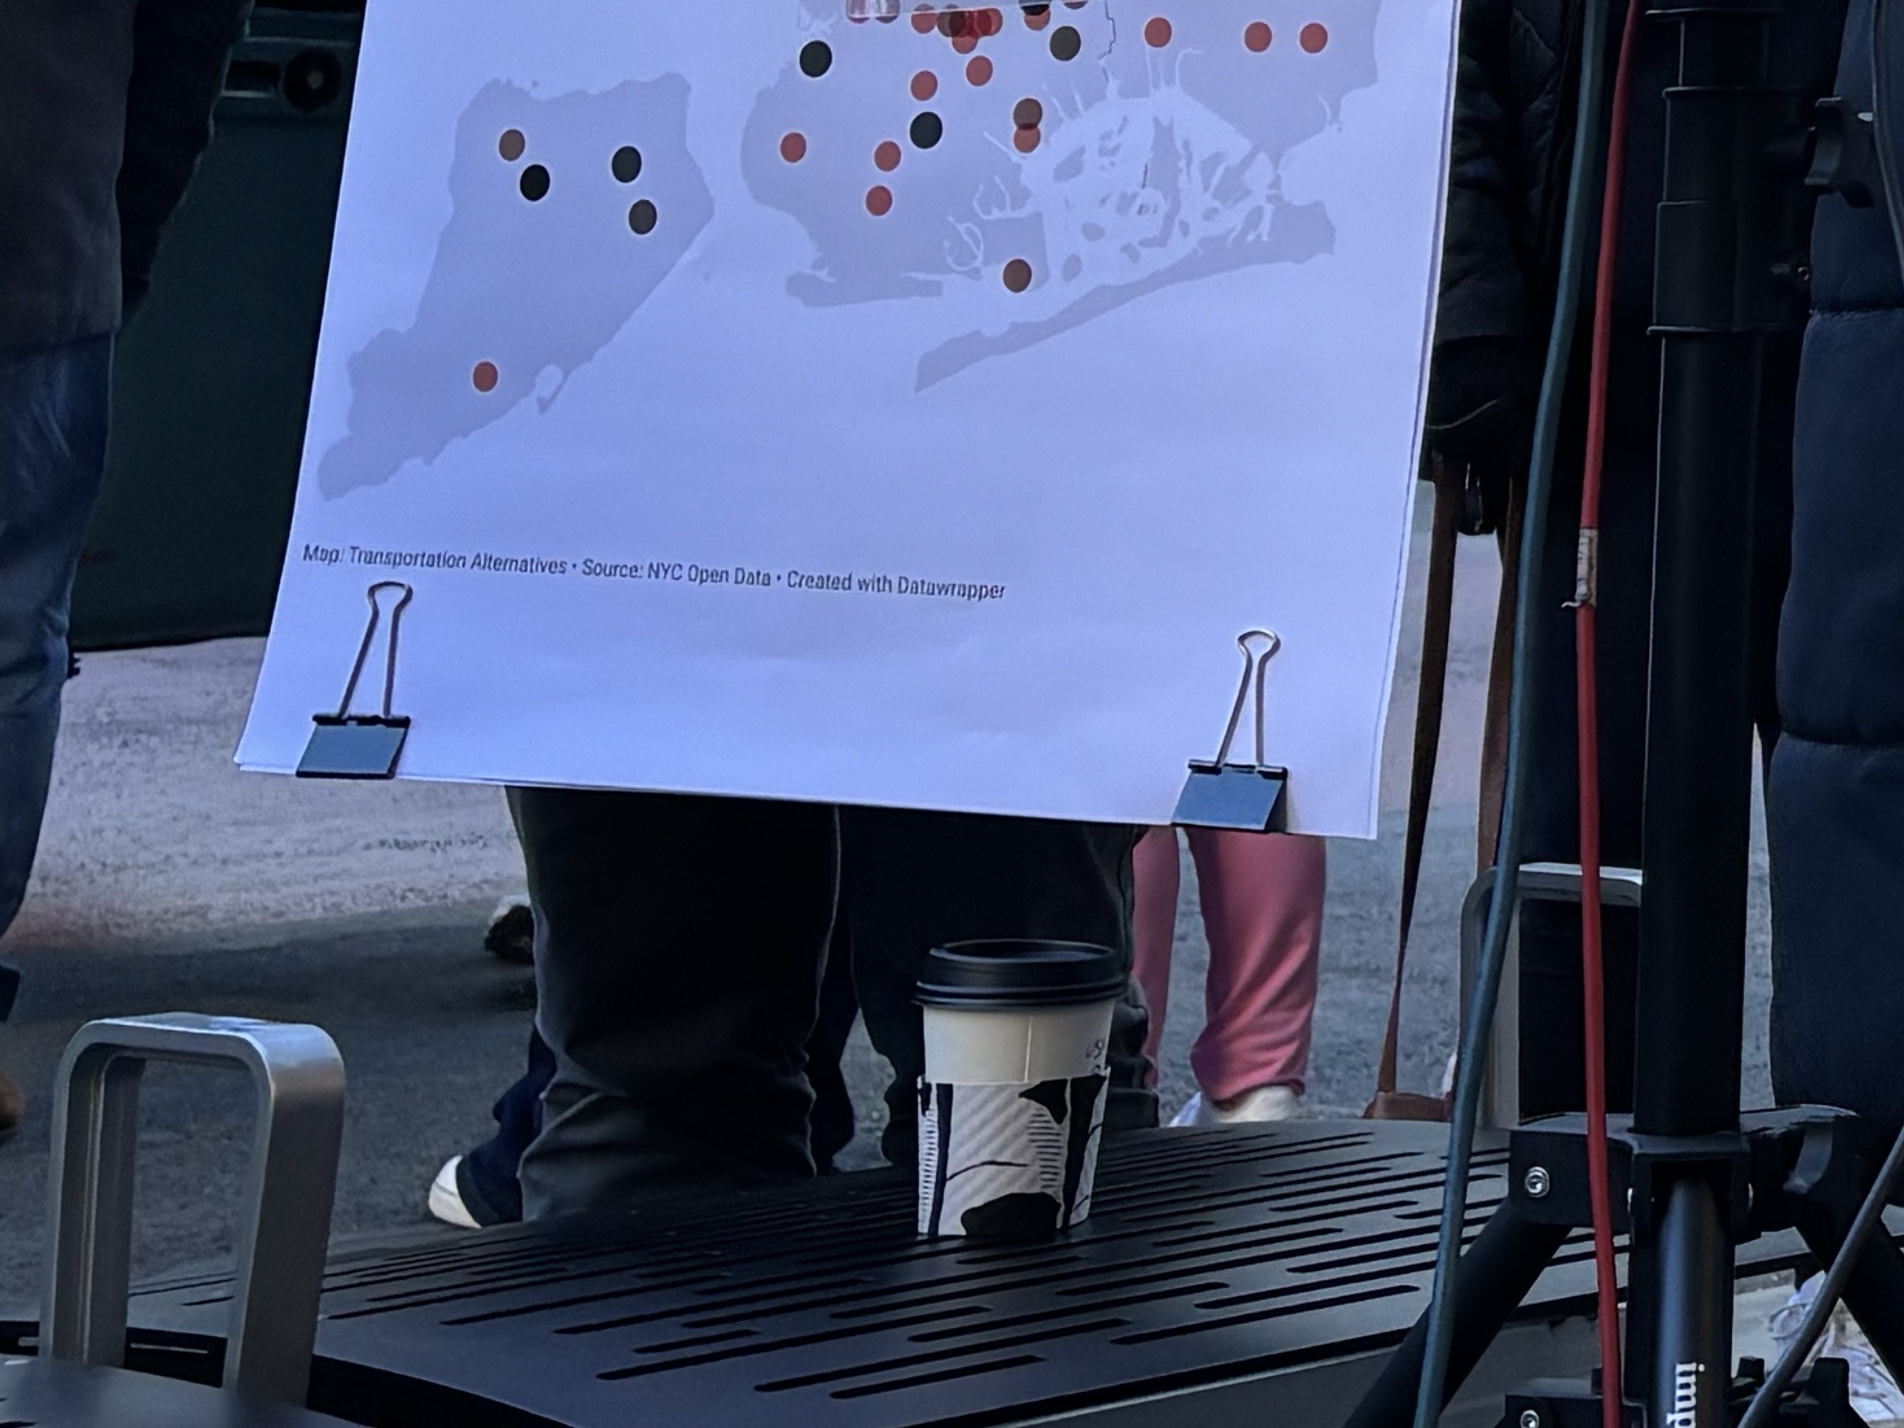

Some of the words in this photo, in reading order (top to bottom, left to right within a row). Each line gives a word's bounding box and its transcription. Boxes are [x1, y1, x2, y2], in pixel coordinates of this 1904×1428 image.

[350, 546, 467, 570] Transportation
[470, 552, 568, 574] Alternatives
[582, 557, 644, 579] Source:
[647, 561, 683, 582] NYC
[688, 563, 730, 586] Open
[734, 567, 772, 587] Data
[787, 570, 853, 591] Created
[857, 574, 893, 593] with
[897, 575, 1006, 601] Datawrapper
